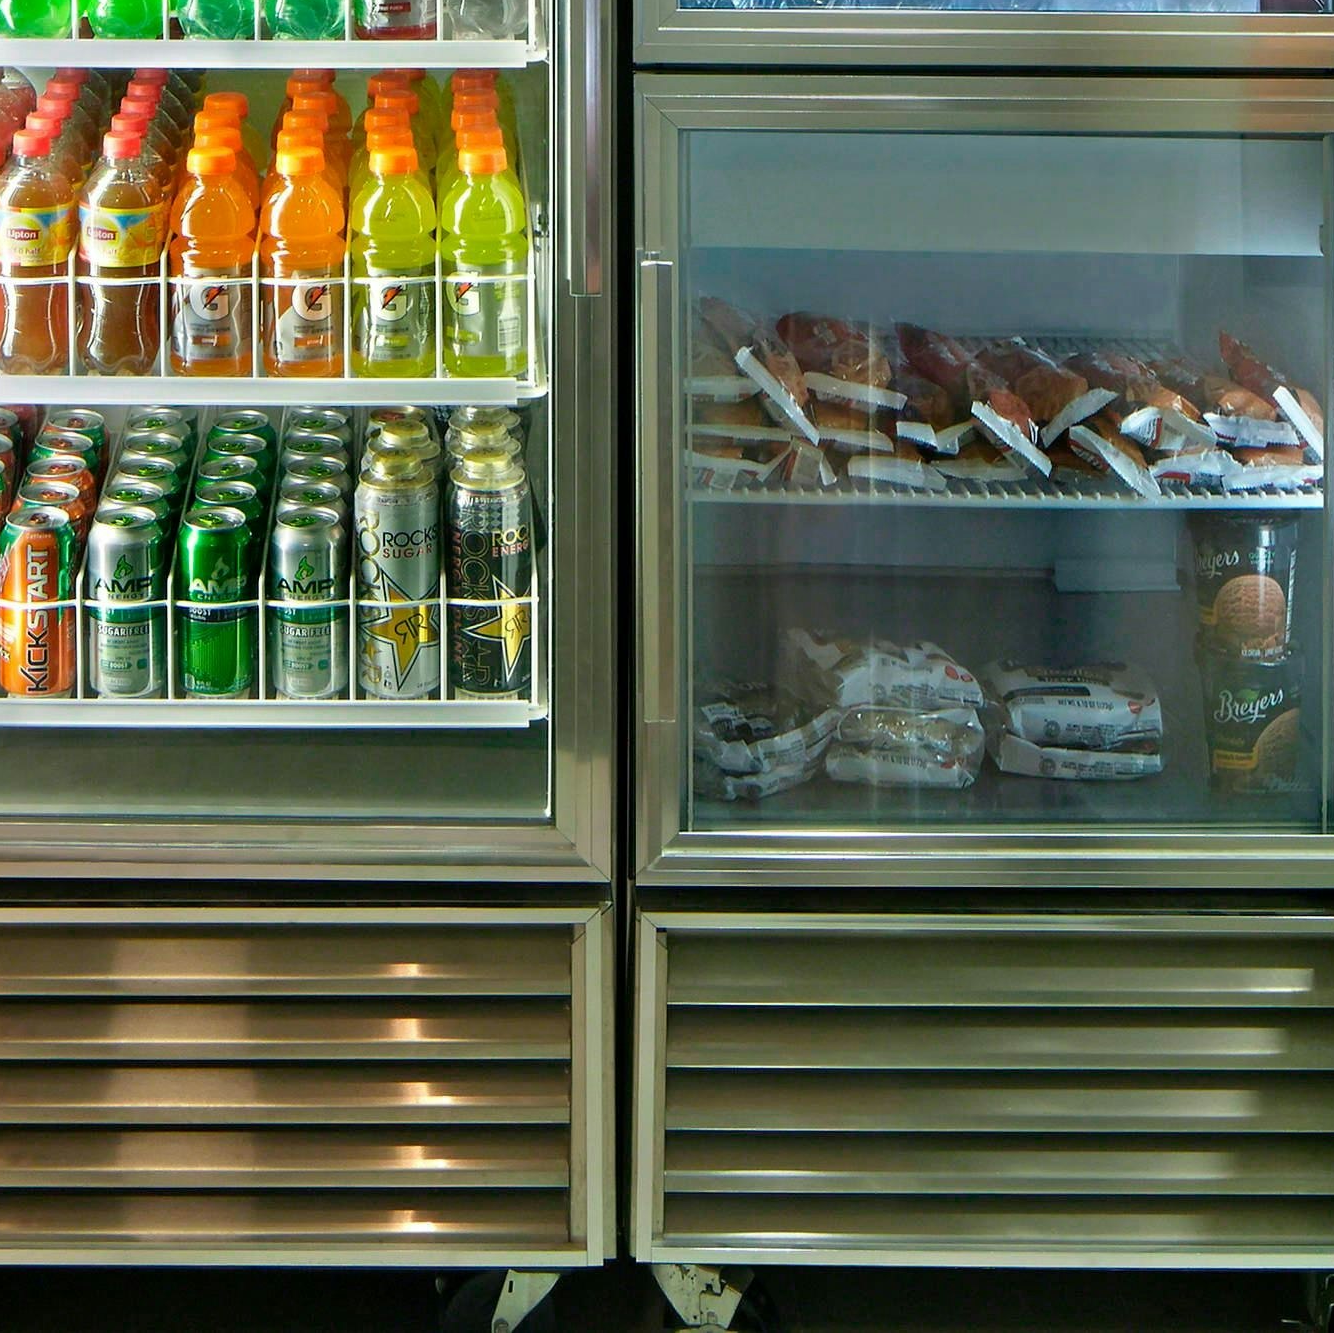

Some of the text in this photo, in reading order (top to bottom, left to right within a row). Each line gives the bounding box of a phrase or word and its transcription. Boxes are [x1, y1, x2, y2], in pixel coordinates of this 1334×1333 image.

[8, 229, 37, 240] Lipton
[382, 545, 433, 558] SUGAR
[94, 576, 153, 593] AMP
[189, 577, 247, 594] AMP
[277, 577, 335, 594] AMP
[19, 544, 48, 692] KICKSTART
[98, 624, 126, 636] SUGAR
[281, 625, 308, 637] SUGAR
[1213, 688, 1284, 725] Breyers
